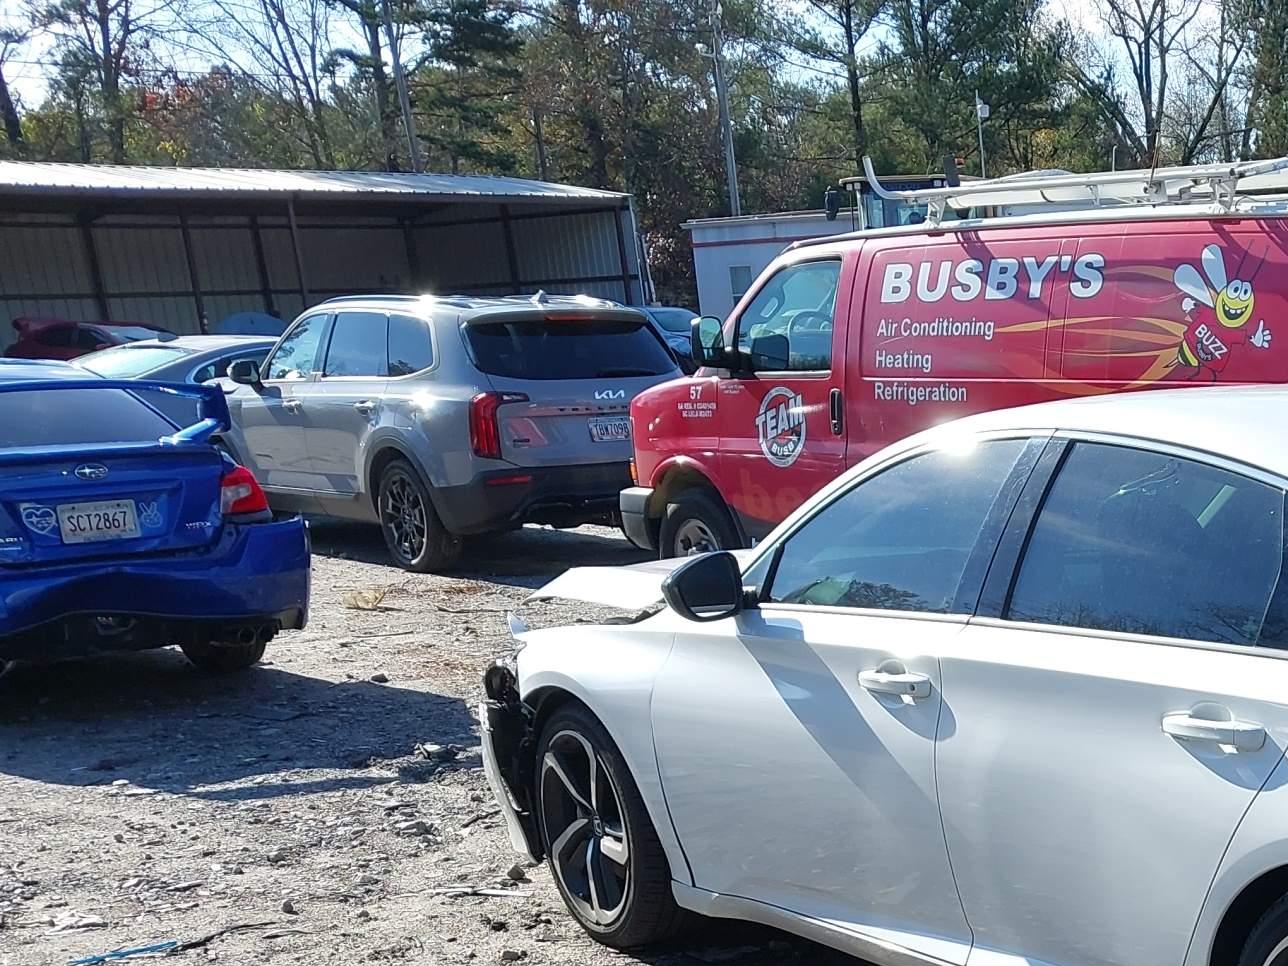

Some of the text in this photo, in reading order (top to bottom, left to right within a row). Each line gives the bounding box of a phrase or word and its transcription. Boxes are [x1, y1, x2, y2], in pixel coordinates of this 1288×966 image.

[880, 253, 1105, 303] BUSBY'S
[877, 317, 995, 340] Air Conditioning
[1195, 323, 1228, 360] BUZZ
[875, 350, 932, 372] Heating
[690, 386, 702, 400] 57
[874, 382, 967, 405] Refrigeration
[755, 394, 803, 444] TEAM
[66, 510, 128, 533] SCT2867
